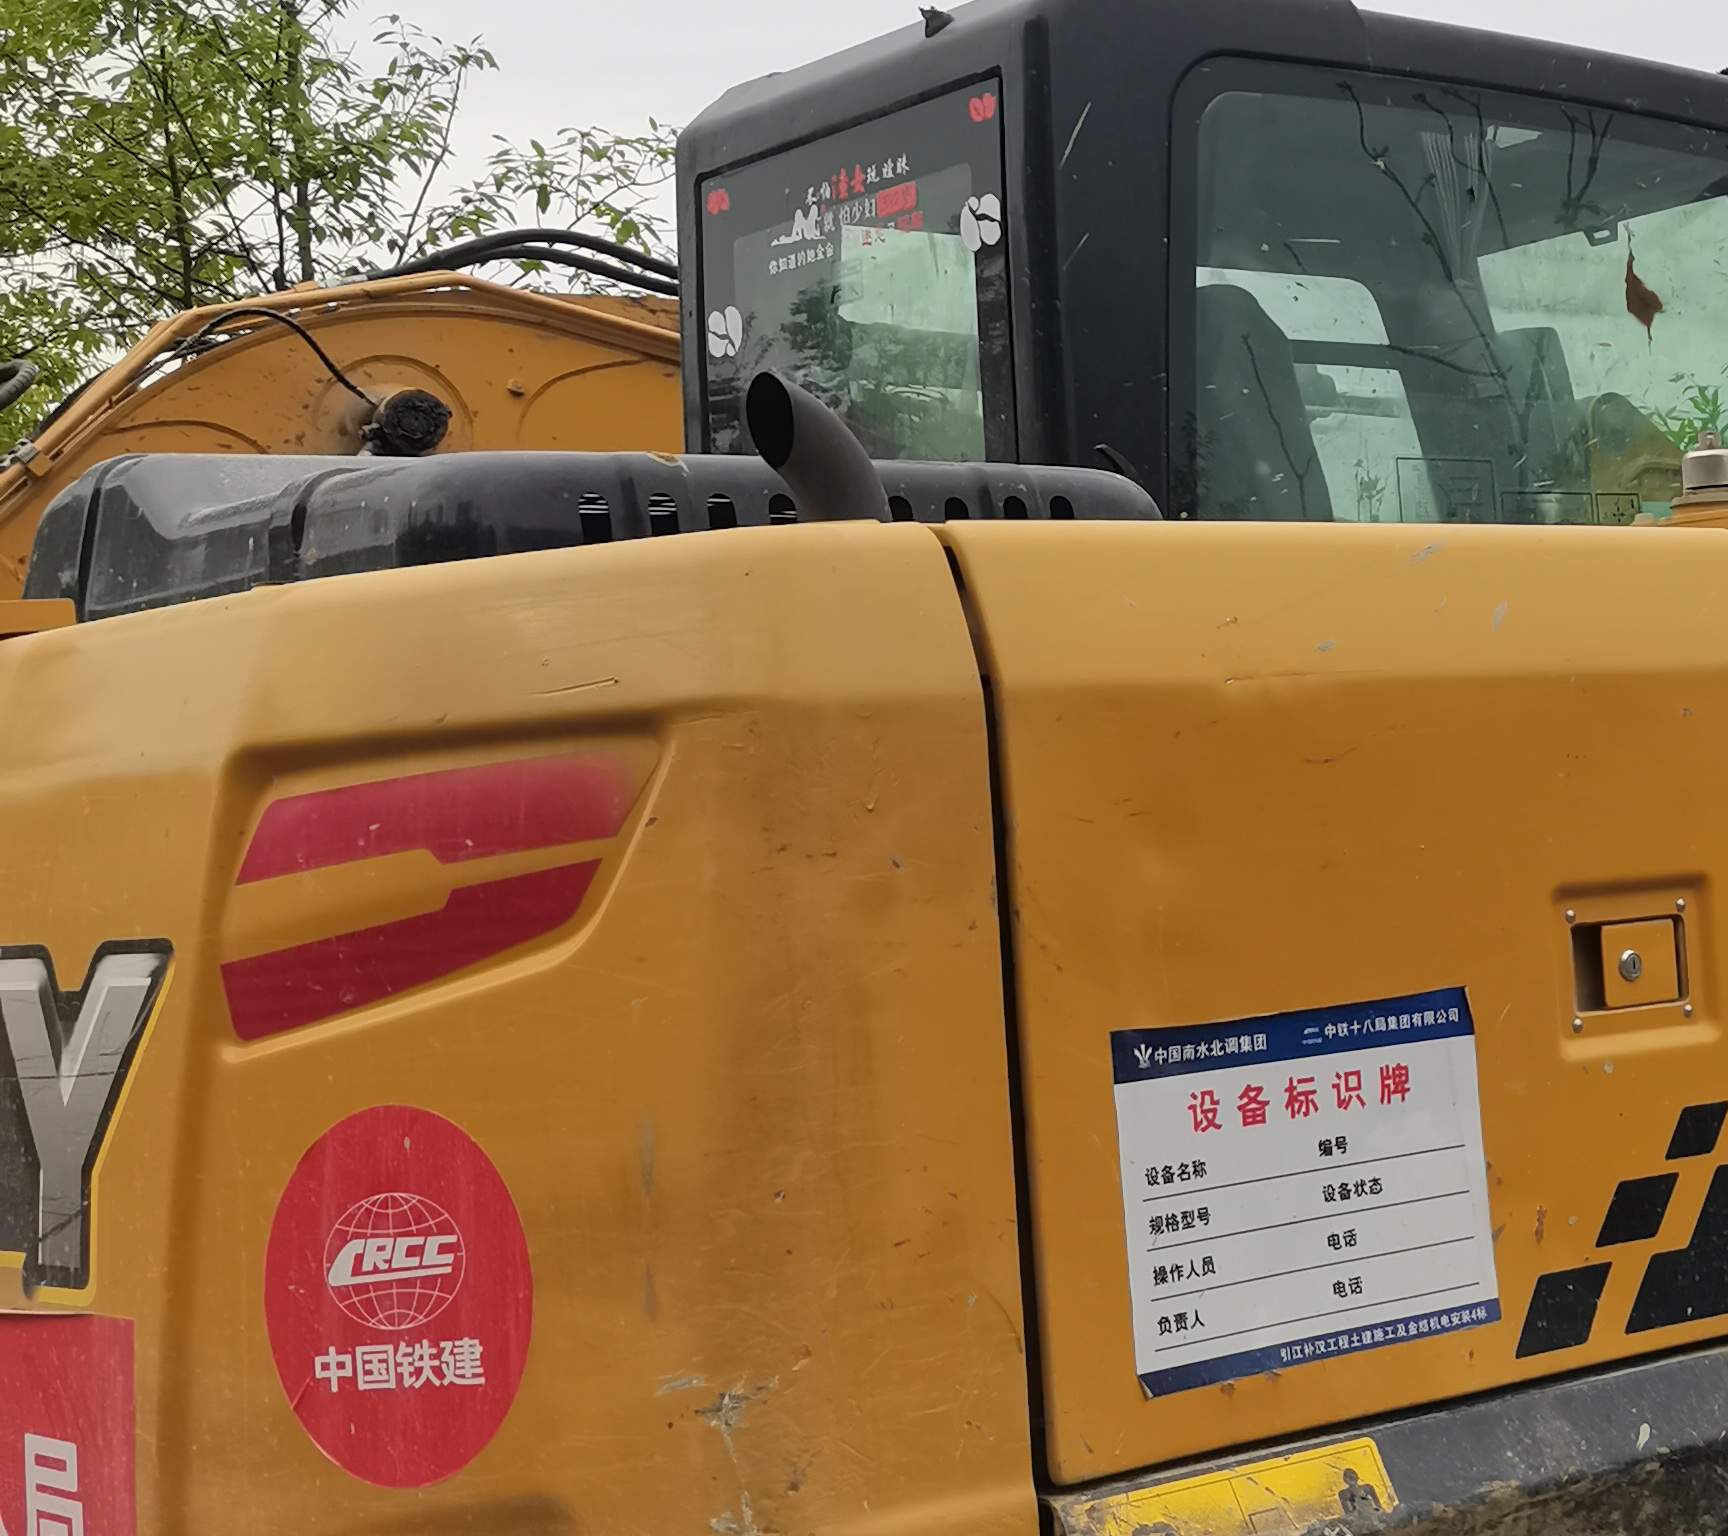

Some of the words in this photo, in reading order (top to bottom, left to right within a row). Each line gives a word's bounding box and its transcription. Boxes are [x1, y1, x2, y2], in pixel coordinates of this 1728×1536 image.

[1323, 1007, 1460, 1040] 中铁十八局集团有限公司
[1154, 1033, 1268, 1065] 中国南水北调集团
[1187, 1062, 1412, 1134] 设备标识牌
[1318, 1135, 1349, 1157] 编号
[1144, 1159, 1208, 1186] 设备名称
[1321, 1177, 1384, 1204] 设备状态
[1148, 1207, 1211, 1236] 规格型号
[1326, 1228, 1358, 1251] 电话
[328, 1234, 458, 1286] CRCC
[1152, 1255, 1217, 1287] 操作人员
[1332, 1275, 1364, 1298] 电话
[1156, 1308, 1206, 1337] 负责人
[314, 1337, 486, 1393] 中国铁建
